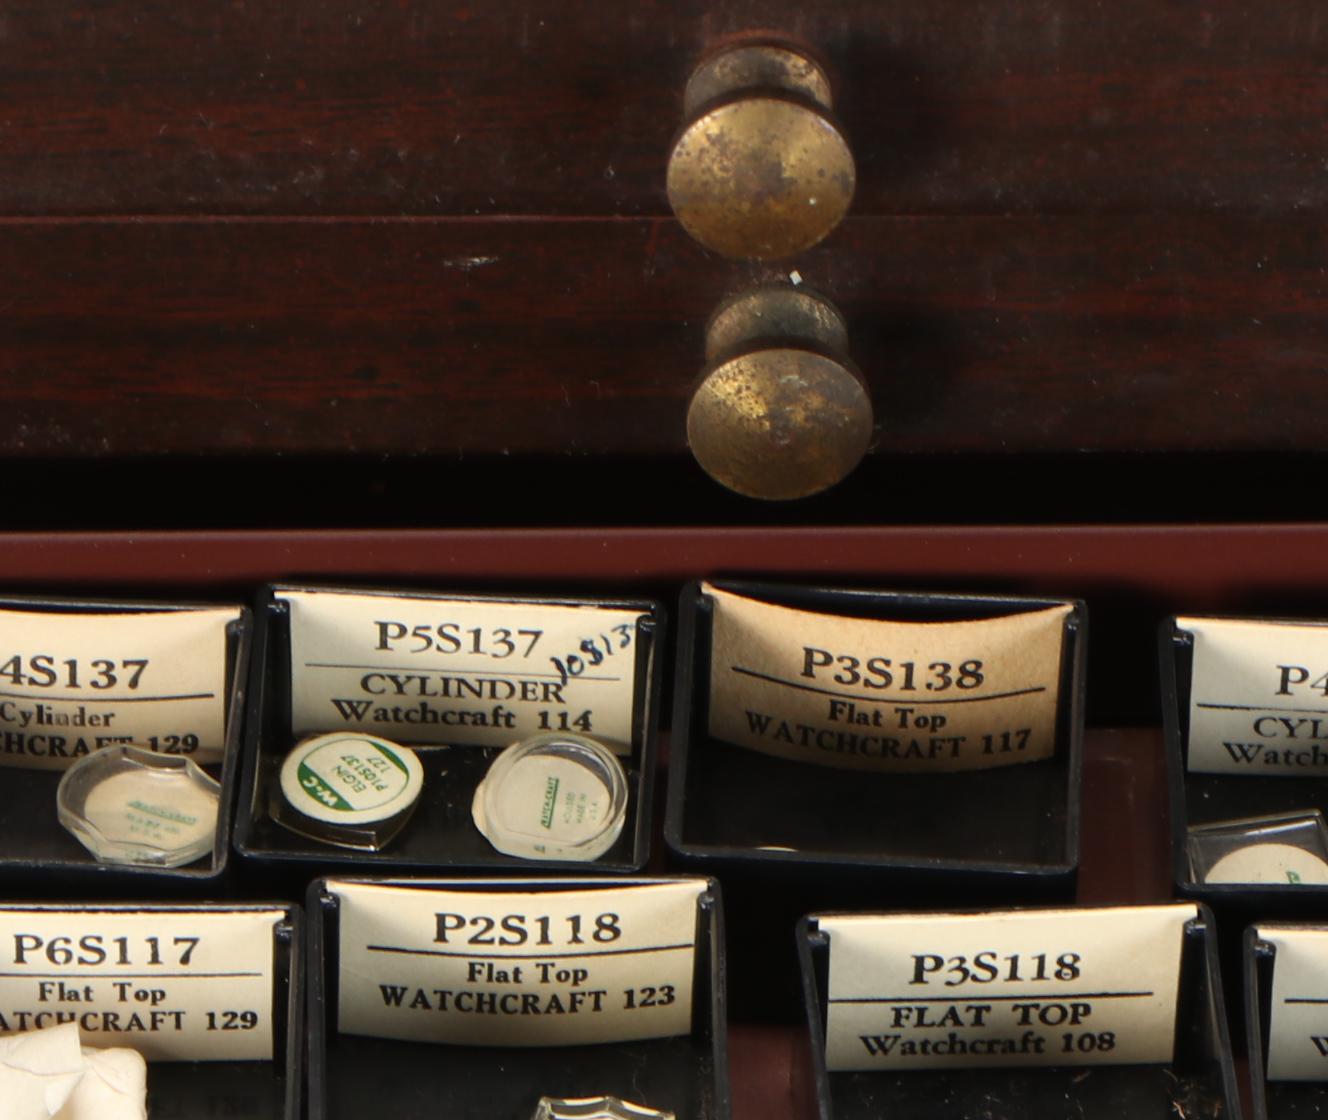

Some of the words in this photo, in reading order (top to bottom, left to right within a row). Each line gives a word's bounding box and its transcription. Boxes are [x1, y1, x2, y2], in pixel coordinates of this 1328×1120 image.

[375, 622, 542, 658] P5S137
[801, 647, 984, 691] P3S138
[361, 674, 569, 703] CYLINDER
[0, 703, 115, 728] Cylinder
[331, 699, 515, 734] Watchcraft
[538, 710, 598, 736] 114
[828, 699, 882, 727] Flat
[895, 708, 946, 733] Top
[331, 765, 362, 793] ELGIN
[340, 755, 385, 792] P10S137
[366, 757, 391, 773] 127
[434, 913, 621, 946] P2S118
[14, 935, 199, 965] P6S117
[467, 962, 522, 984] Flat
[536, 963, 588, 986] Top
[909, 952, 1080, 986] P3S118
[39, 982, 93, 1002] Flat
[113, 983, 166, 1006] Top
[206, 1011, 257, 1030] 129
[891, 1005, 991, 1028] FLAT
[1012, 1003, 1091, 1026] TOP
[859, 1031, 1045, 1056] Watchcraft
[1062, 1032, 1115, 1052] 108
